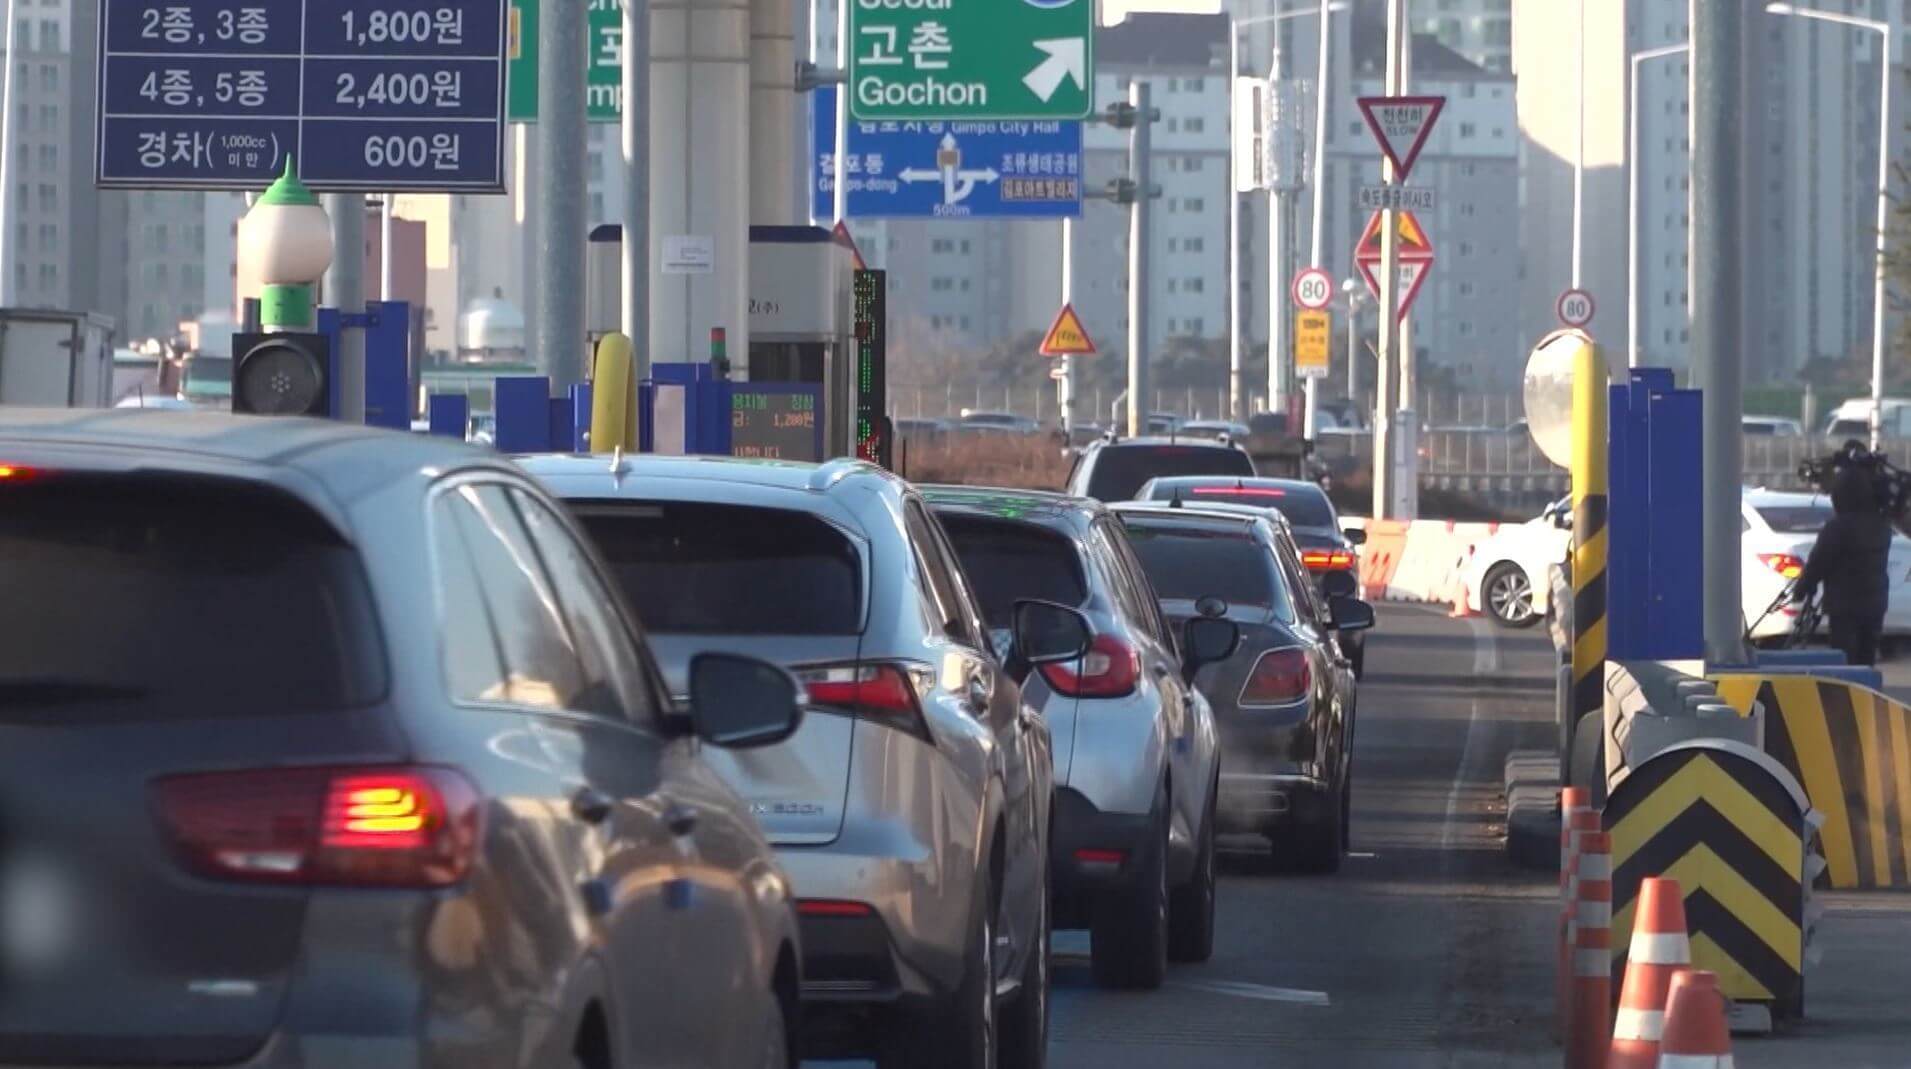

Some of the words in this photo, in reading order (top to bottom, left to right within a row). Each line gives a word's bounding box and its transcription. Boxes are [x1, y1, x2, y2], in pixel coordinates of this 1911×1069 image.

[141, 7, 205, 44] 2종,
[216, 8, 269, 44] 3종
[342, 8, 462, 46] 1,800원
[858, 21, 952, 69] 고촌
[139, 69, 204, 107] 4종,
[215, 70, 268, 107] 5종
[336, 71, 461, 108] 2,400원
[858, 76, 987, 106] Gochon
[1000, 121, 1029, 135] City
[1033, 121, 1060, 133] Hall
[221, 135, 267, 149] 1,000cc
[364, 133, 460, 170] 600원
[1302, 279, 1325, 300] 80
[1566, 299, 1586, 318] 80
